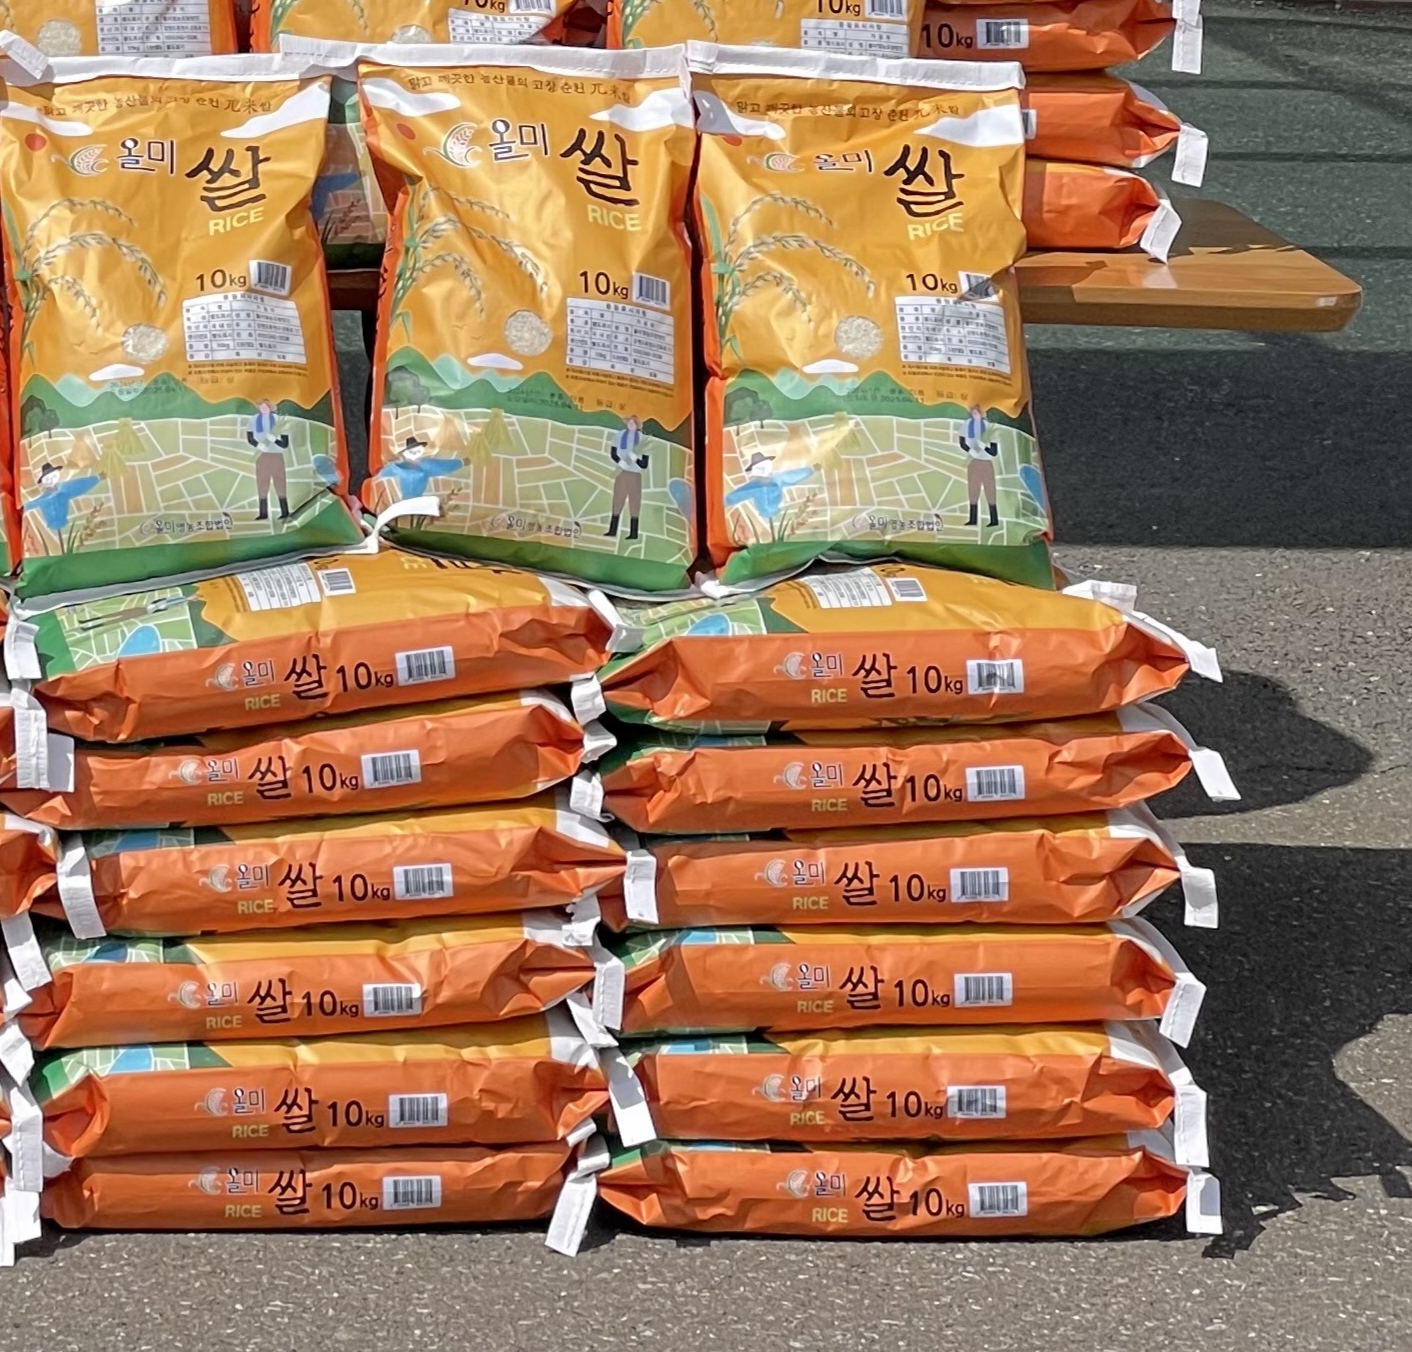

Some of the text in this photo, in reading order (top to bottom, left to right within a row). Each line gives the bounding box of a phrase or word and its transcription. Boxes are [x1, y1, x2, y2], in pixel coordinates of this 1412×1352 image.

[921, 22, 973, 50] 10kg
[117, 137, 270, 212] 올미 쌀
[489, 119, 638, 206] 올미 쌀
[883, 144, 964, 217] 쌀
[209, 206, 264, 236] RICE
[588, 203, 642, 231] RICE
[907, 212, 964, 240] RICE
[195, 269, 247, 292] 10kg
[579, 270, 629, 299] 10kg
[906, 273, 958, 293] 10kg
[242, 653, 394, 699] 올미 쌀 10kg
[811, 652, 963, 699] 올미 쌀 10kg
[245, 694, 280, 710] RICE
[811, 688, 847, 703] RICE
[207, 755, 358, 799] 올미 쌀 10kg
[208, 791, 244, 805] RICE
[792, 859, 946, 906] 올미 쌀 10kg
[793, 896, 829, 910] RICE
[207, 977, 359, 1023] 올미 쌀 10kg
[797, 963, 950, 1010] 올미 쌀 10kg
[797, 1000, 833, 1013] RICE
[206, 1015, 242, 1029] RICE
[226, 1167, 379, 1215] 올미 쌀 10kg
[815, 1171, 964, 1221] 올미 쌀 10kg
[225, 1204, 262, 1217] RICE
[812, 1207, 848, 1223] RICE
